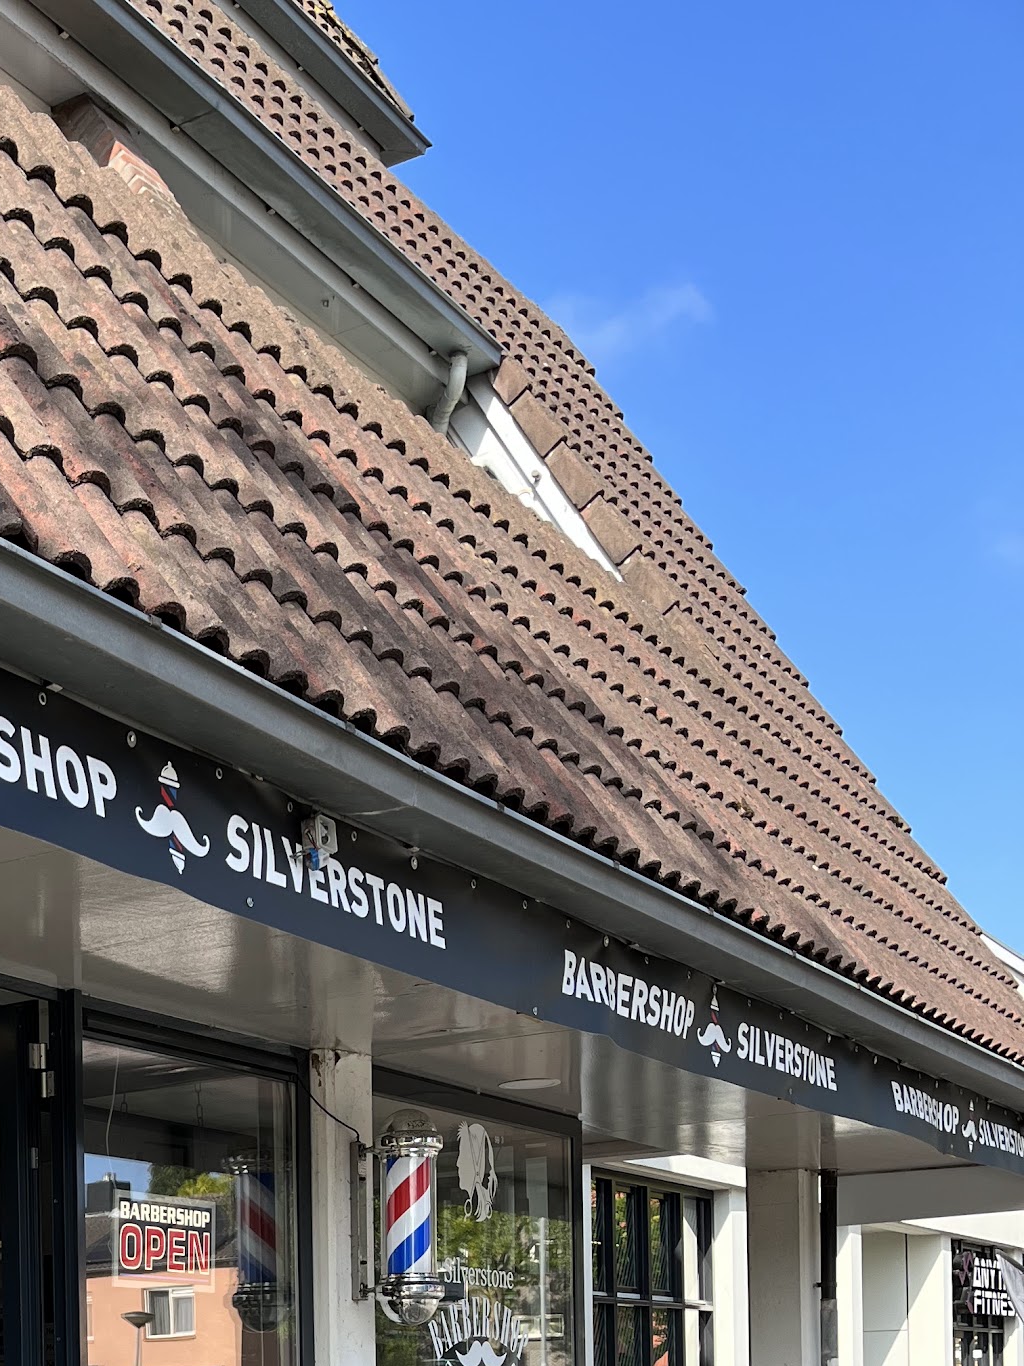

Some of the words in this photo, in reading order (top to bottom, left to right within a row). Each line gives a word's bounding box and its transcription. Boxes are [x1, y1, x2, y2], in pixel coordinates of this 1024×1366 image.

[225, 814, 446, 950] SILVERSTONE
[562, 949, 695, 1040] BARBERSHOP
[736, 1022, 838, 1092] SILVERSTONE
[891, 1081, 960, 1135] BARBERSHOP
[120, 1200, 211, 1228] BARBERSHOP
[119, 1222, 211, 1276] OPEN
[442, 1257, 514, 1290] Silverstone
[428, 1296, 529, 1361] BARBERSHOP
